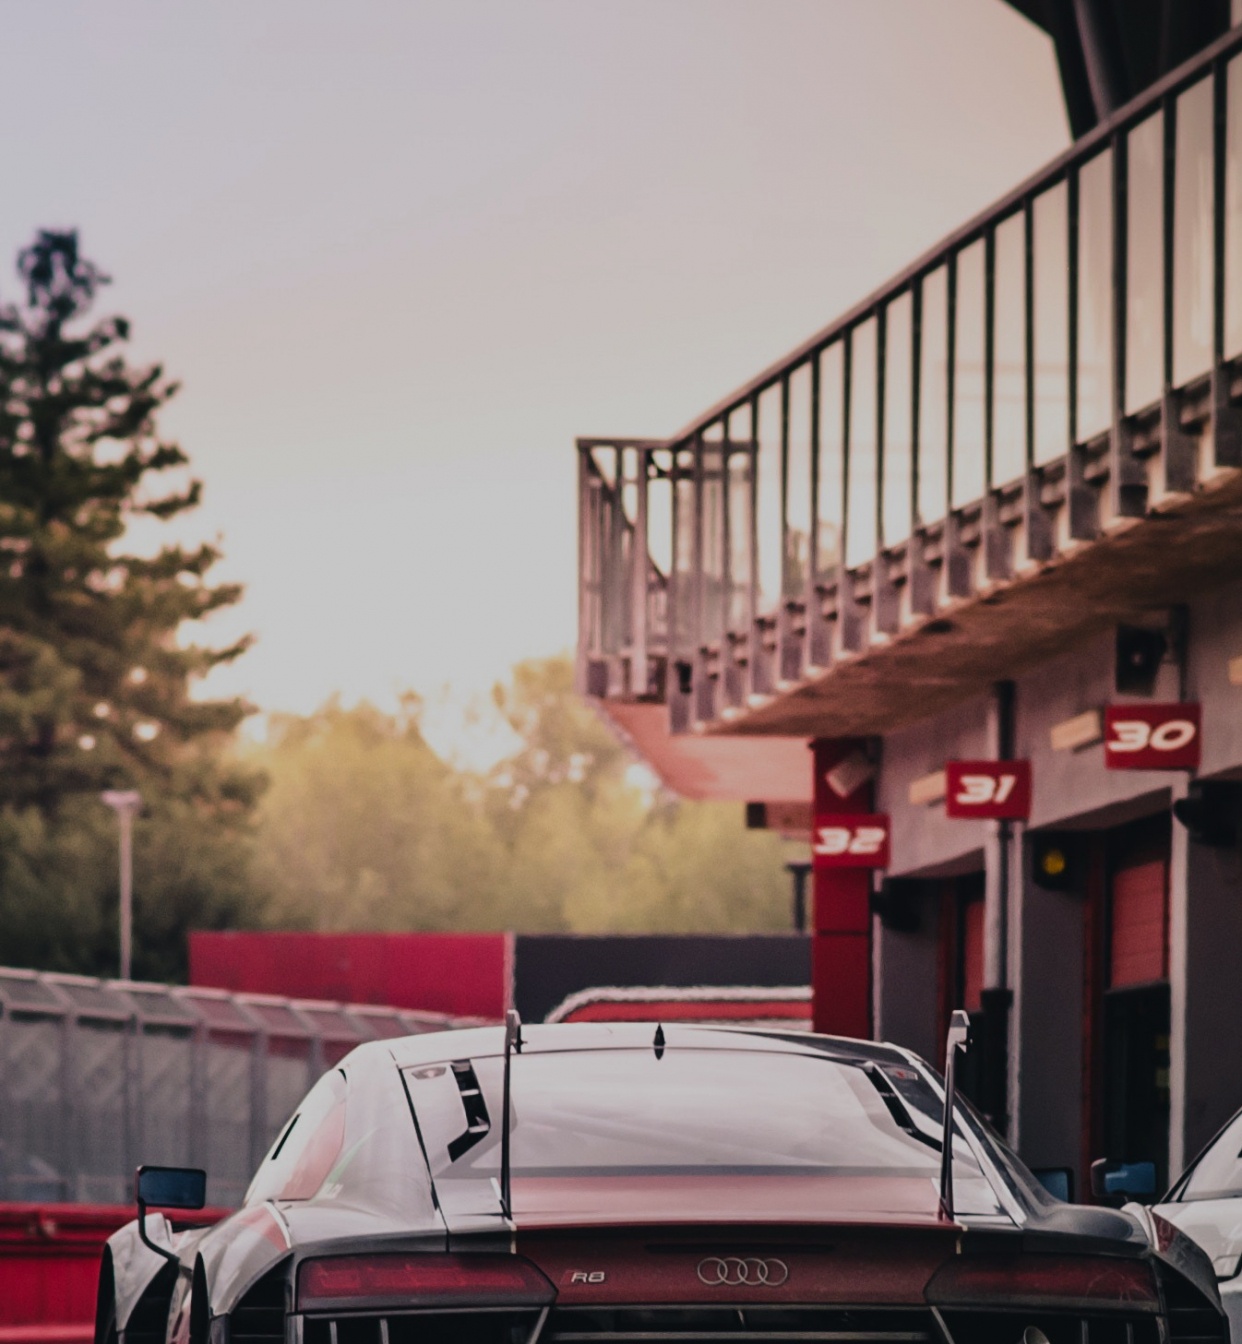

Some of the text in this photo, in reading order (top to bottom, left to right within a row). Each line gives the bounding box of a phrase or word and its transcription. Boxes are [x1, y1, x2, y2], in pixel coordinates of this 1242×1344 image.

[1108, 720, 1196, 752] 30
[955, 774, 1017, 804] 31
[814, 827, 885, 855] 32
[570, 1271, 605, 1283] R8
